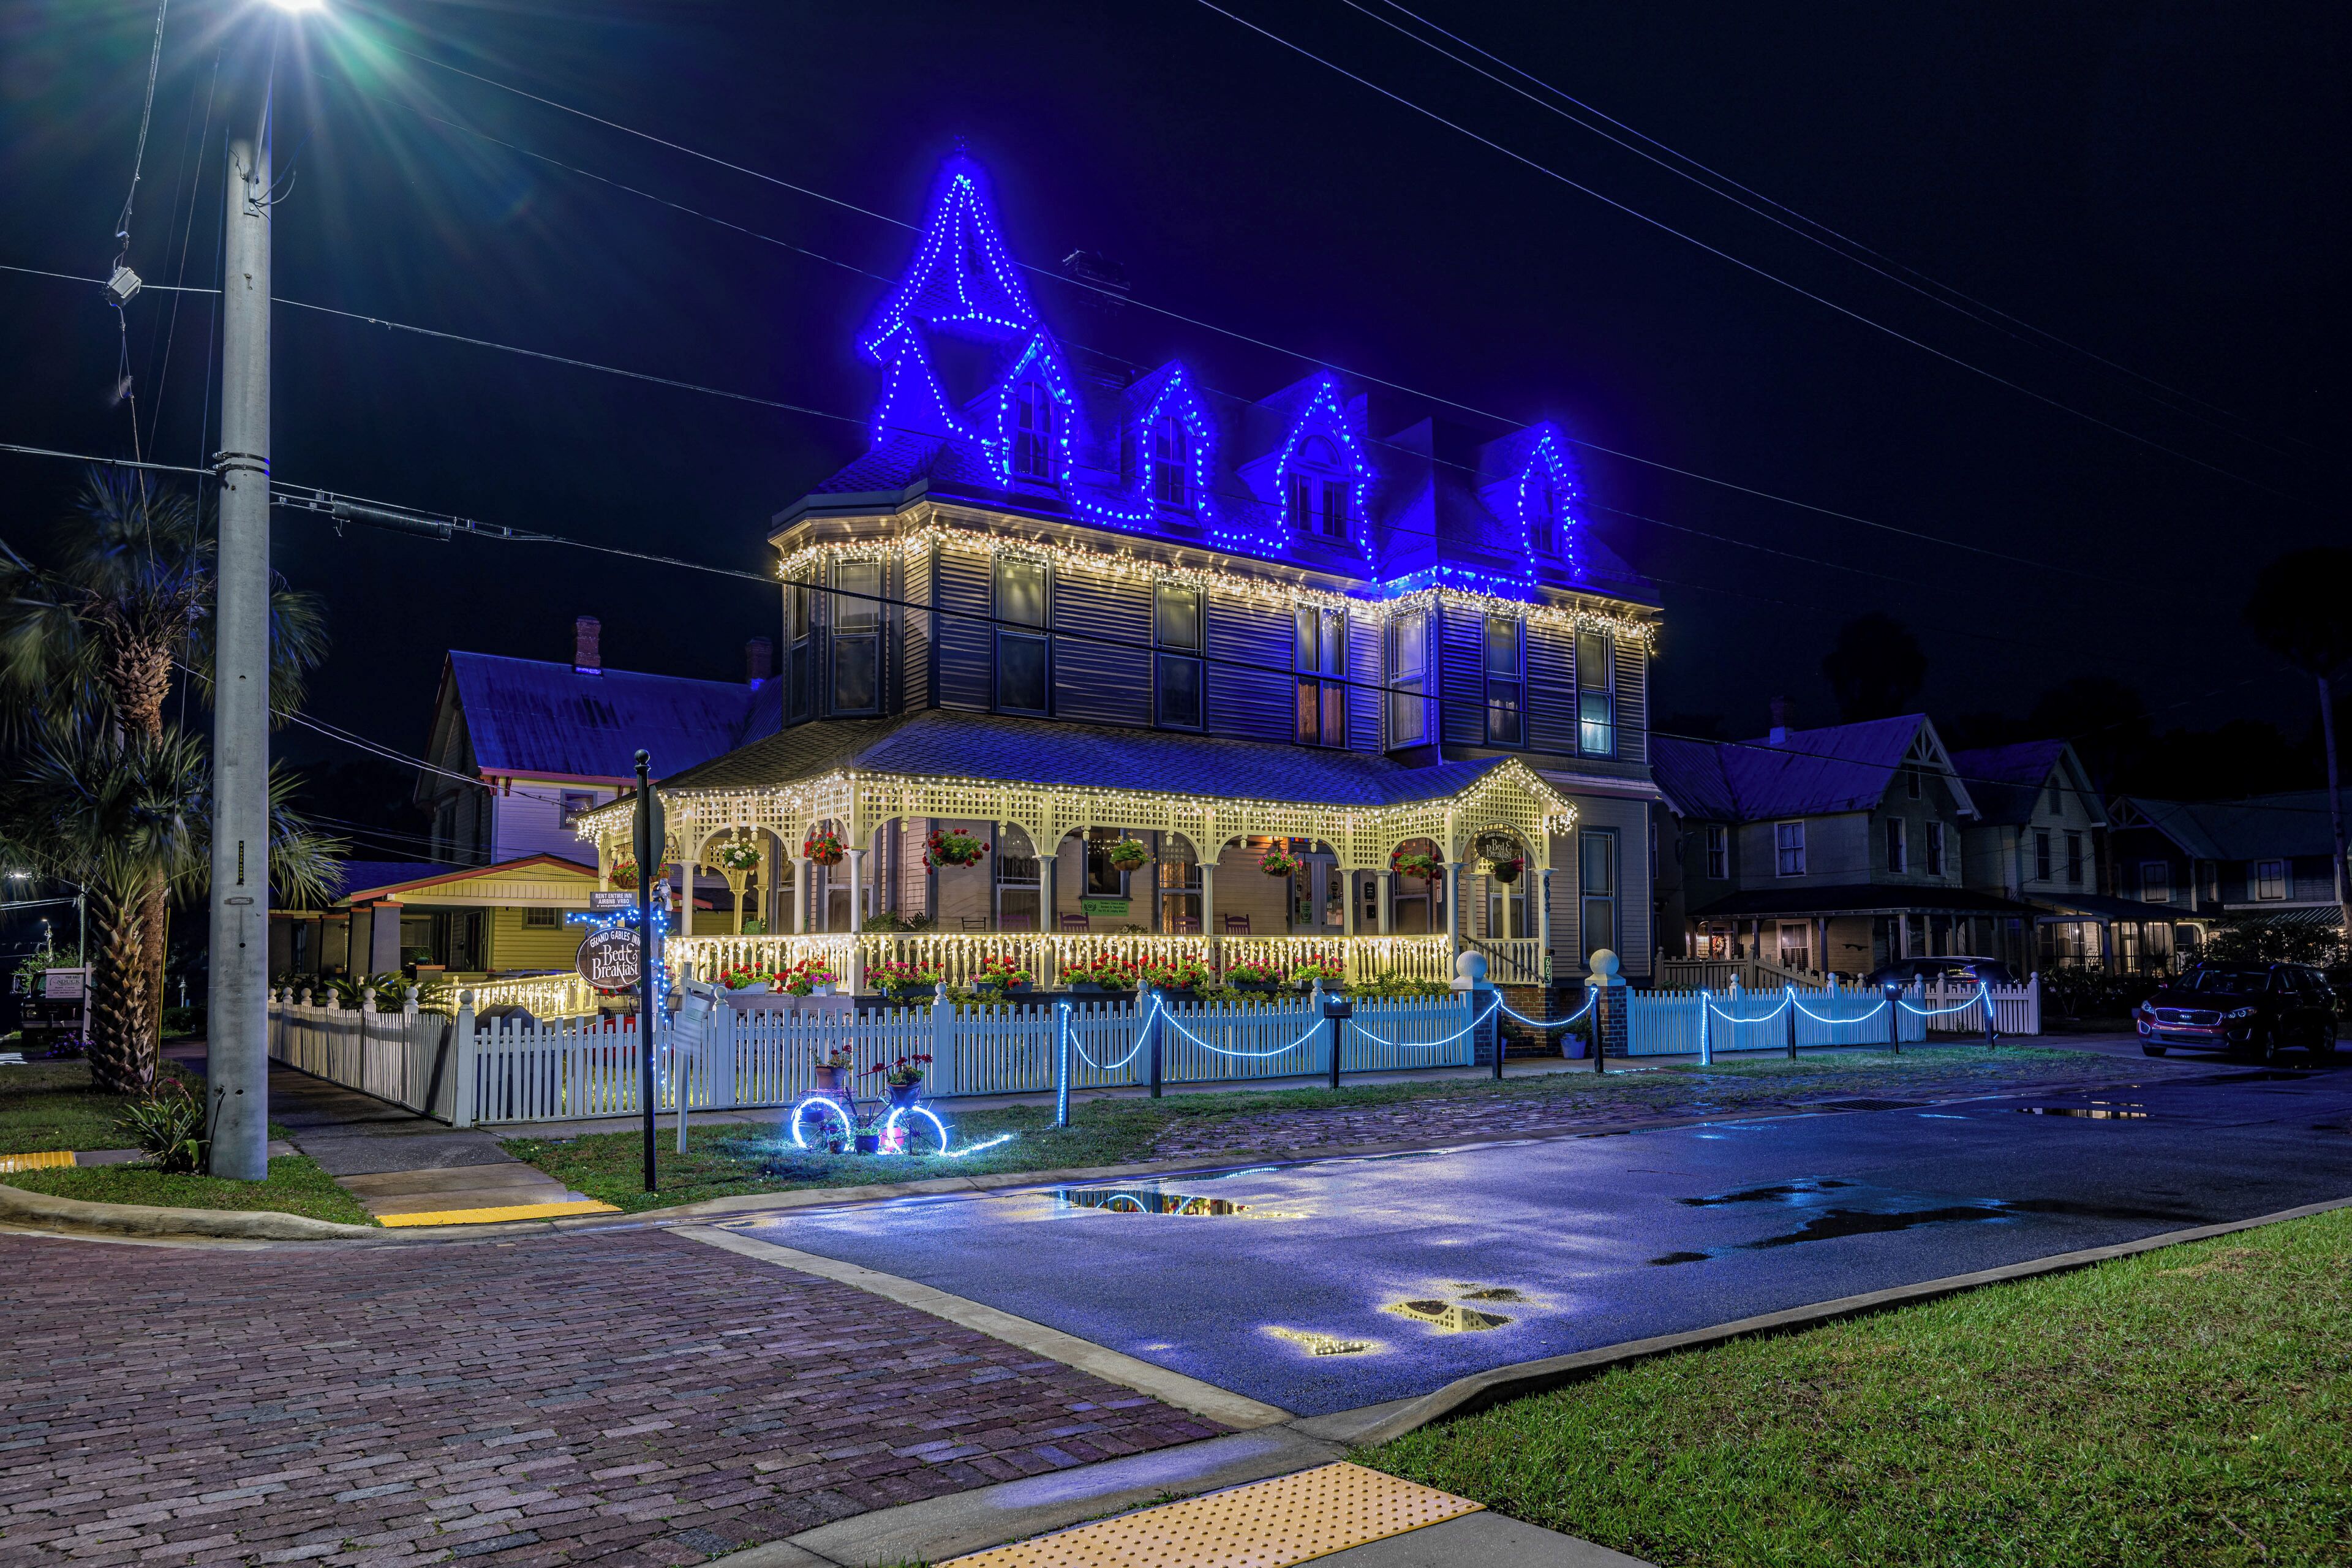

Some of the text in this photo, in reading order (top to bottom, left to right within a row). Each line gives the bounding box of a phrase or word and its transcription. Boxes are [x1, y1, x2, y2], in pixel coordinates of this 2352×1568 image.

[1487, 845, 1511, 860] Breakfast
[1491, 839, 1512, 853] Bed &
[590, 930, 641, 948] GRAND GABLES INN
[603, 943, 638, 966] Bed &
[592, 958, 639, 982] Breakfast
